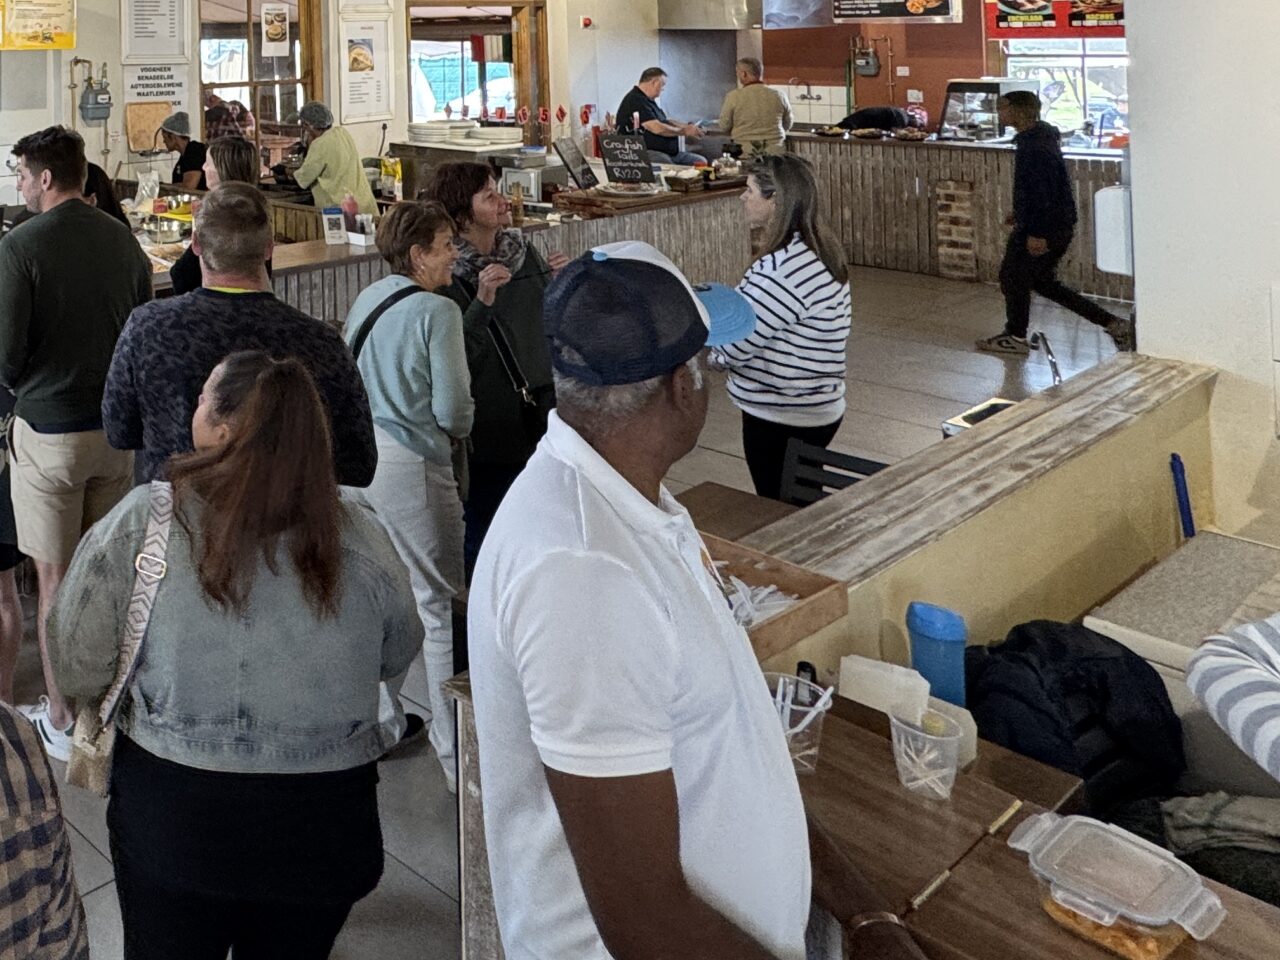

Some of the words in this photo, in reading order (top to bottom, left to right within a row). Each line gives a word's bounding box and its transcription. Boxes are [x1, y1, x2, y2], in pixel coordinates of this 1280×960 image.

[541, 109, 548, 122] 5
[603, 139, 643, 153] Crayfish
[613, 150, 639, 160] Tails
